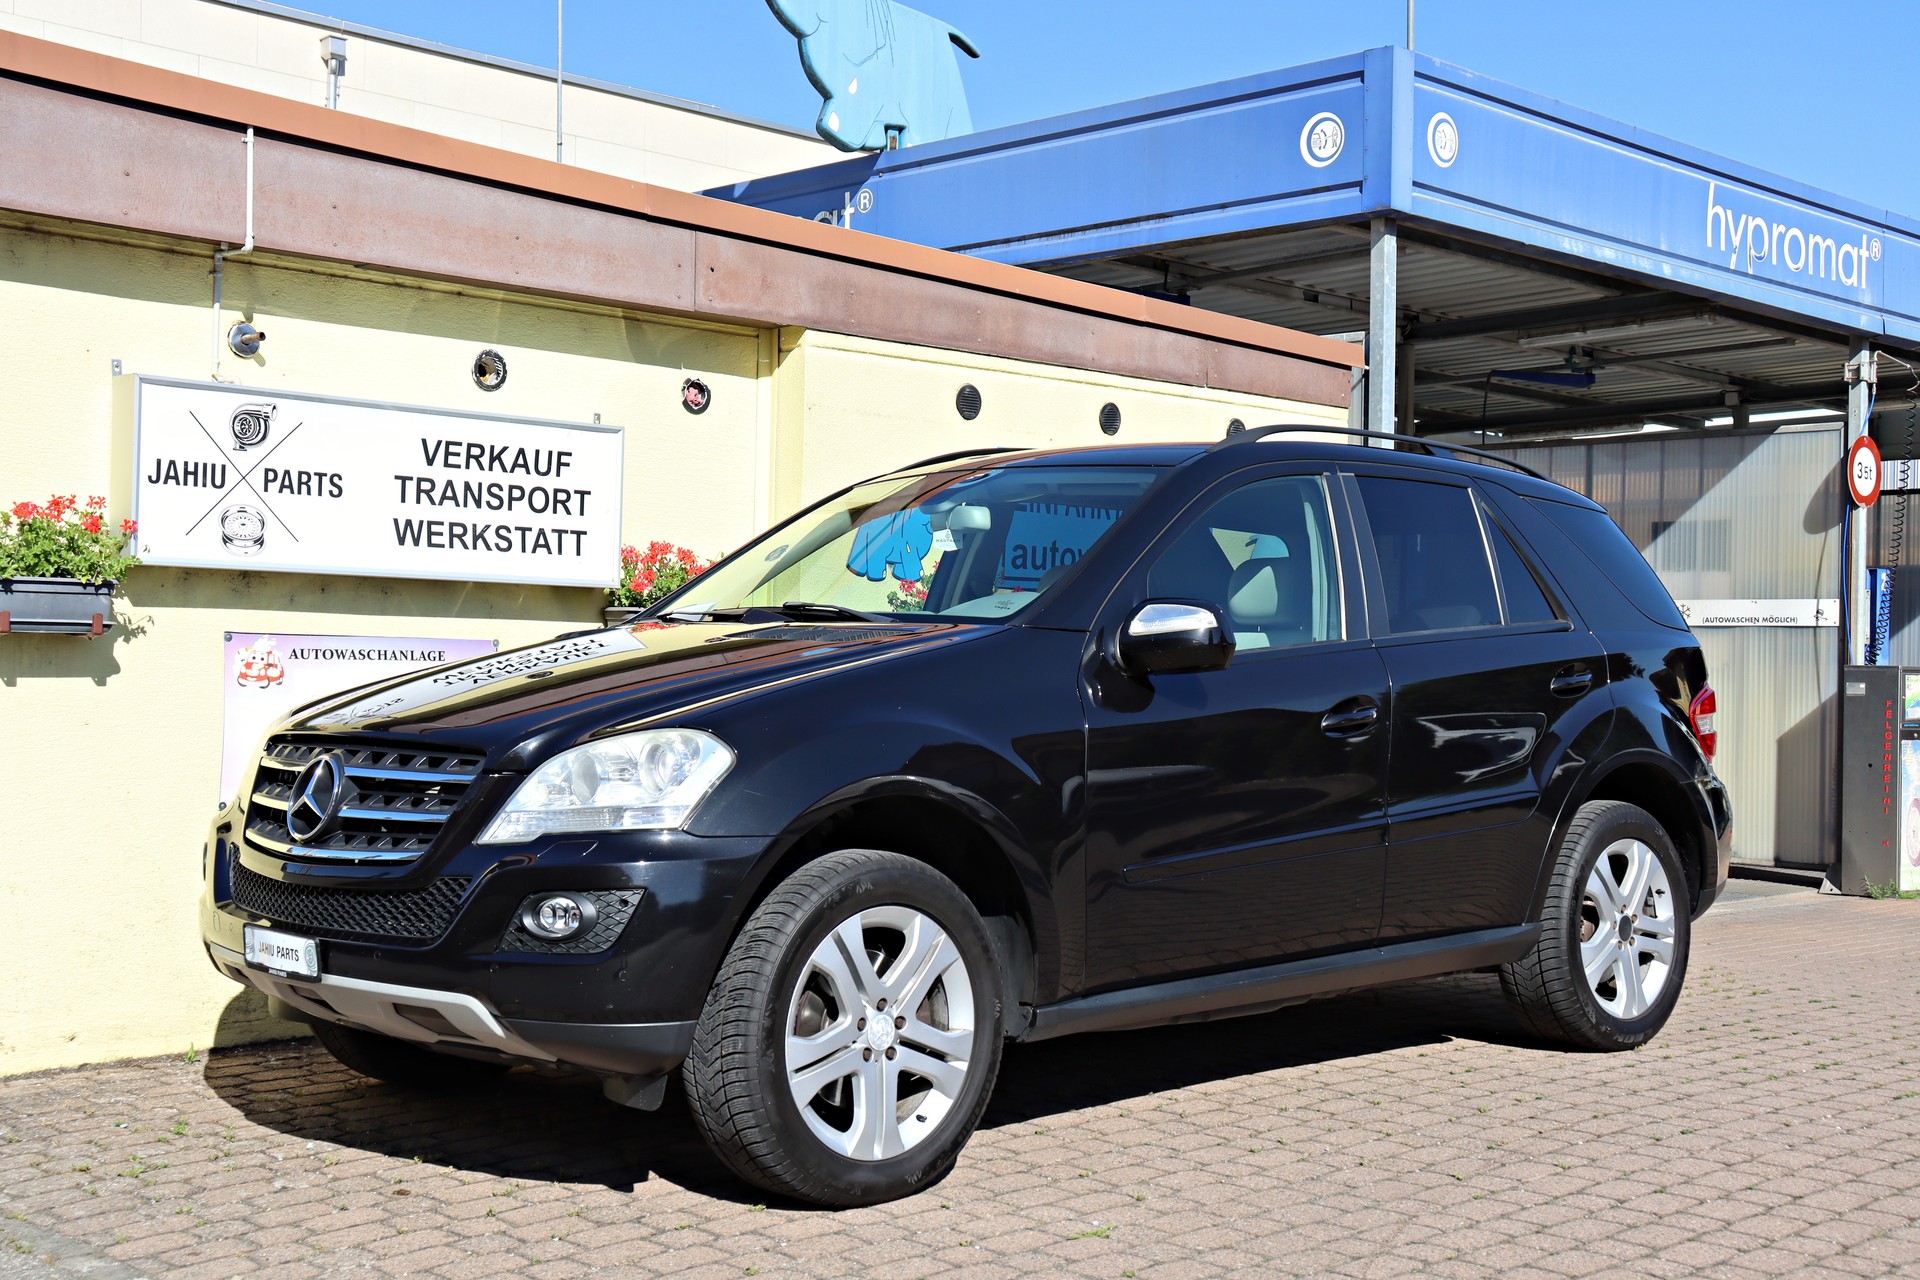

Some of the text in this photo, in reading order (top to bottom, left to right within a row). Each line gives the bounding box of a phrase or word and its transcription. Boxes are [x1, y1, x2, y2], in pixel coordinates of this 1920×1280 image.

[421, 438, 573, 477] VERKAUF
[147, 458, 343, 498] JAHIU PARTS
[394, 475, 592, 516] TRANSPORT
[393, 518, 588, 557] WERKSTATT
[288, 648, 446, 661] AUTOWASCHANLAGE
[259, 941, 299, 961] JAHIU PARTS
